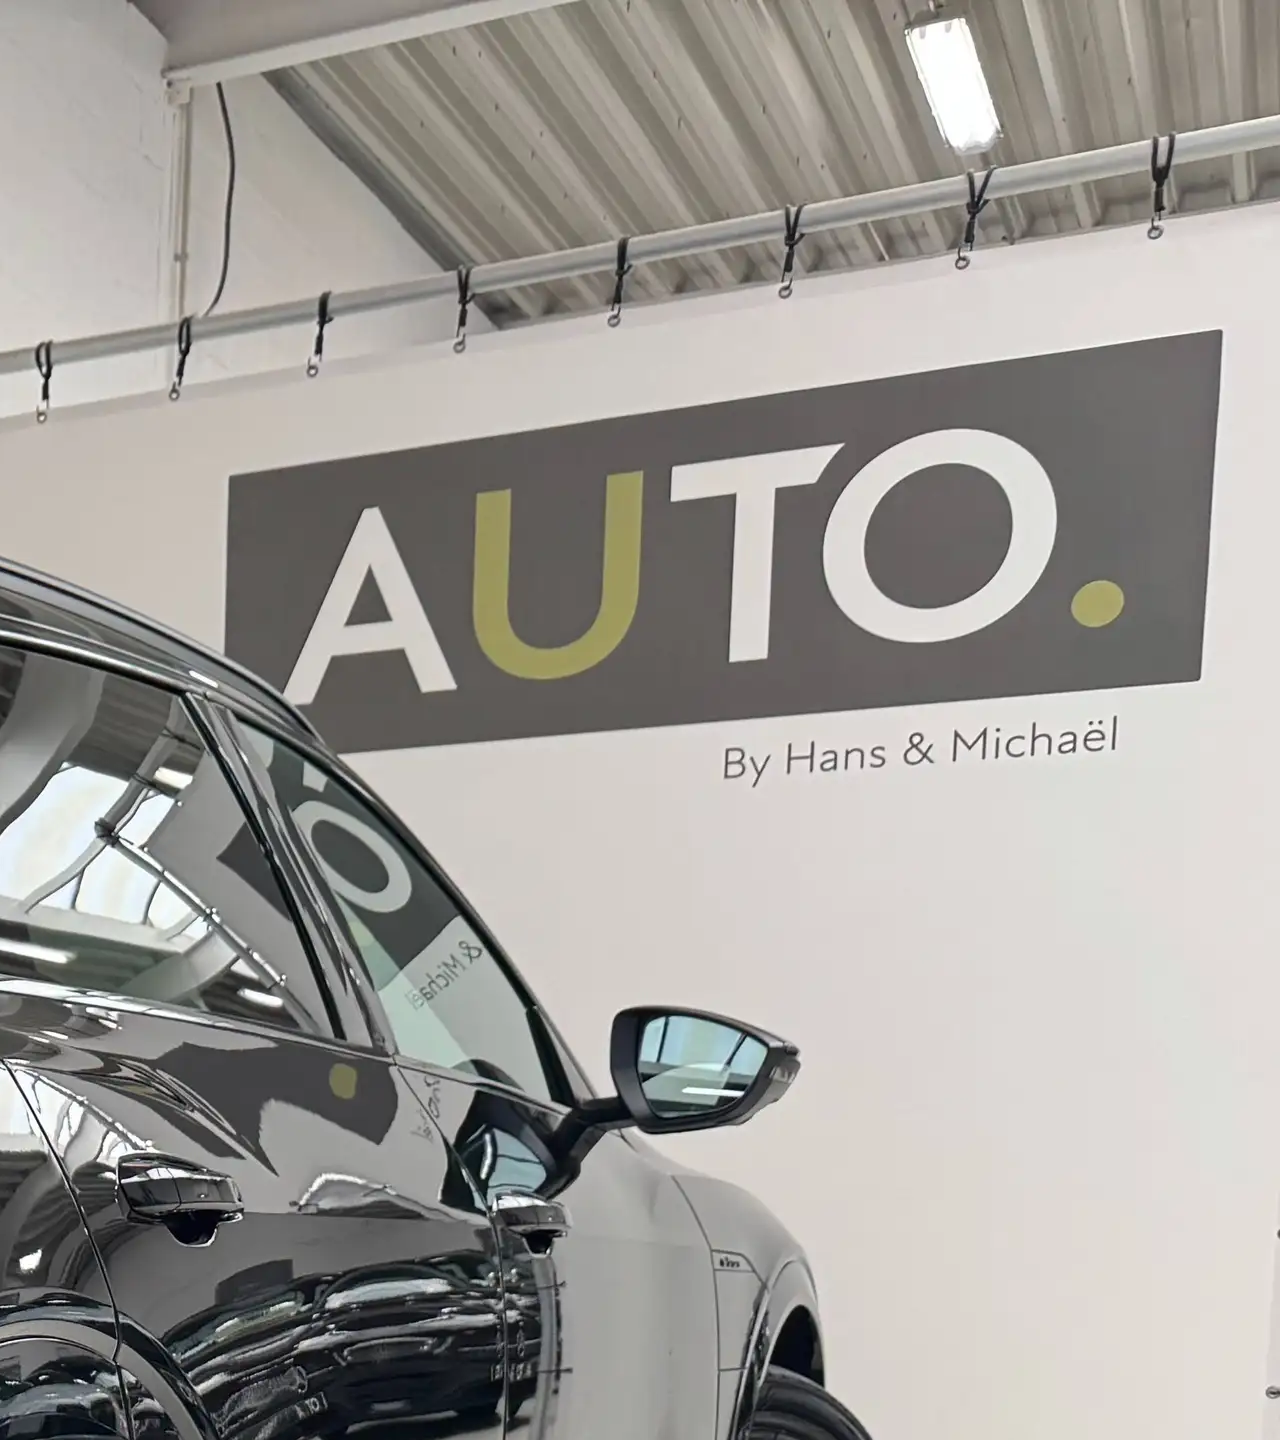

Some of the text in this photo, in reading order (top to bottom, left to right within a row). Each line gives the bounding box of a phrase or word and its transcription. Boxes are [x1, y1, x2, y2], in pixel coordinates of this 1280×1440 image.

[284, 427, 1124, 706] AUTO.
[722, 716, 1118, 788] By Hans & Michaël
